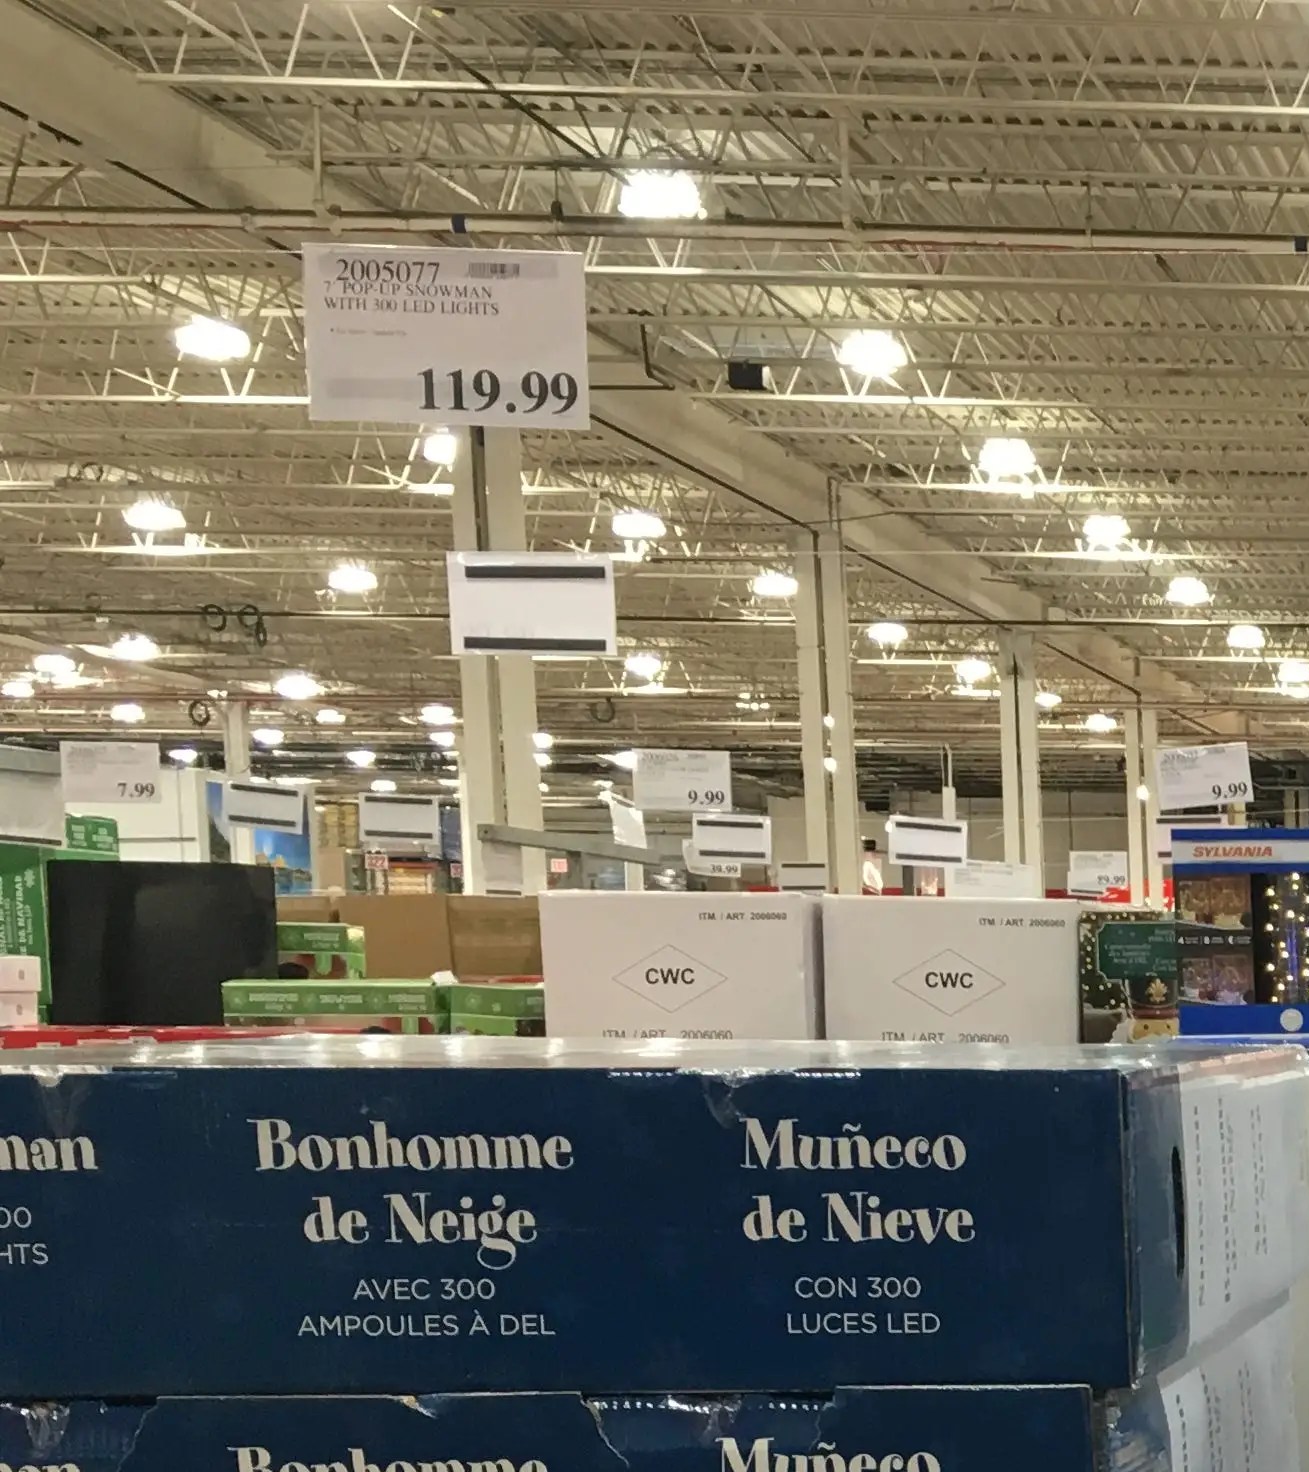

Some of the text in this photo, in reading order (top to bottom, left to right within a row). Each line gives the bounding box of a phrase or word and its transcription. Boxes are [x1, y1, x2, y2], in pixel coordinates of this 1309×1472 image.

[336, 259, 440, 284] 2005077
[343, 281, 400, 295] POP-UP
[406, 284, 492, 298] SNOWMAN
[324, 297, 499, 315] WITH 300 LED LIGHTS
[419, 369, 577, 414] 119.99
[118, 783, 155, 797] 7.99
[688, 791, 724, 804] 9.99
[1212, 783, 1247, 799] 9.99
[1193, 846, 1273, 857] SYLVANIA
[646, 968, 694, 984] CWC
[925, 972, 973, 988] CWC
[247, 1119, 573, 1171] Bonhomme
[736, 1113, 966, 1170] Muñeco
[743, 1192, 975, 1244] de Nieve
[304, 1193, 537, 1270] de Neige
[354, 1279, 495, 1300] AVEC 300
[795, 1277, 921, 1298] CON 300
[298, 1310, 555, 1336] AMPOULES À DEL
[787, 1313, 940, 1333] LUCES LED
